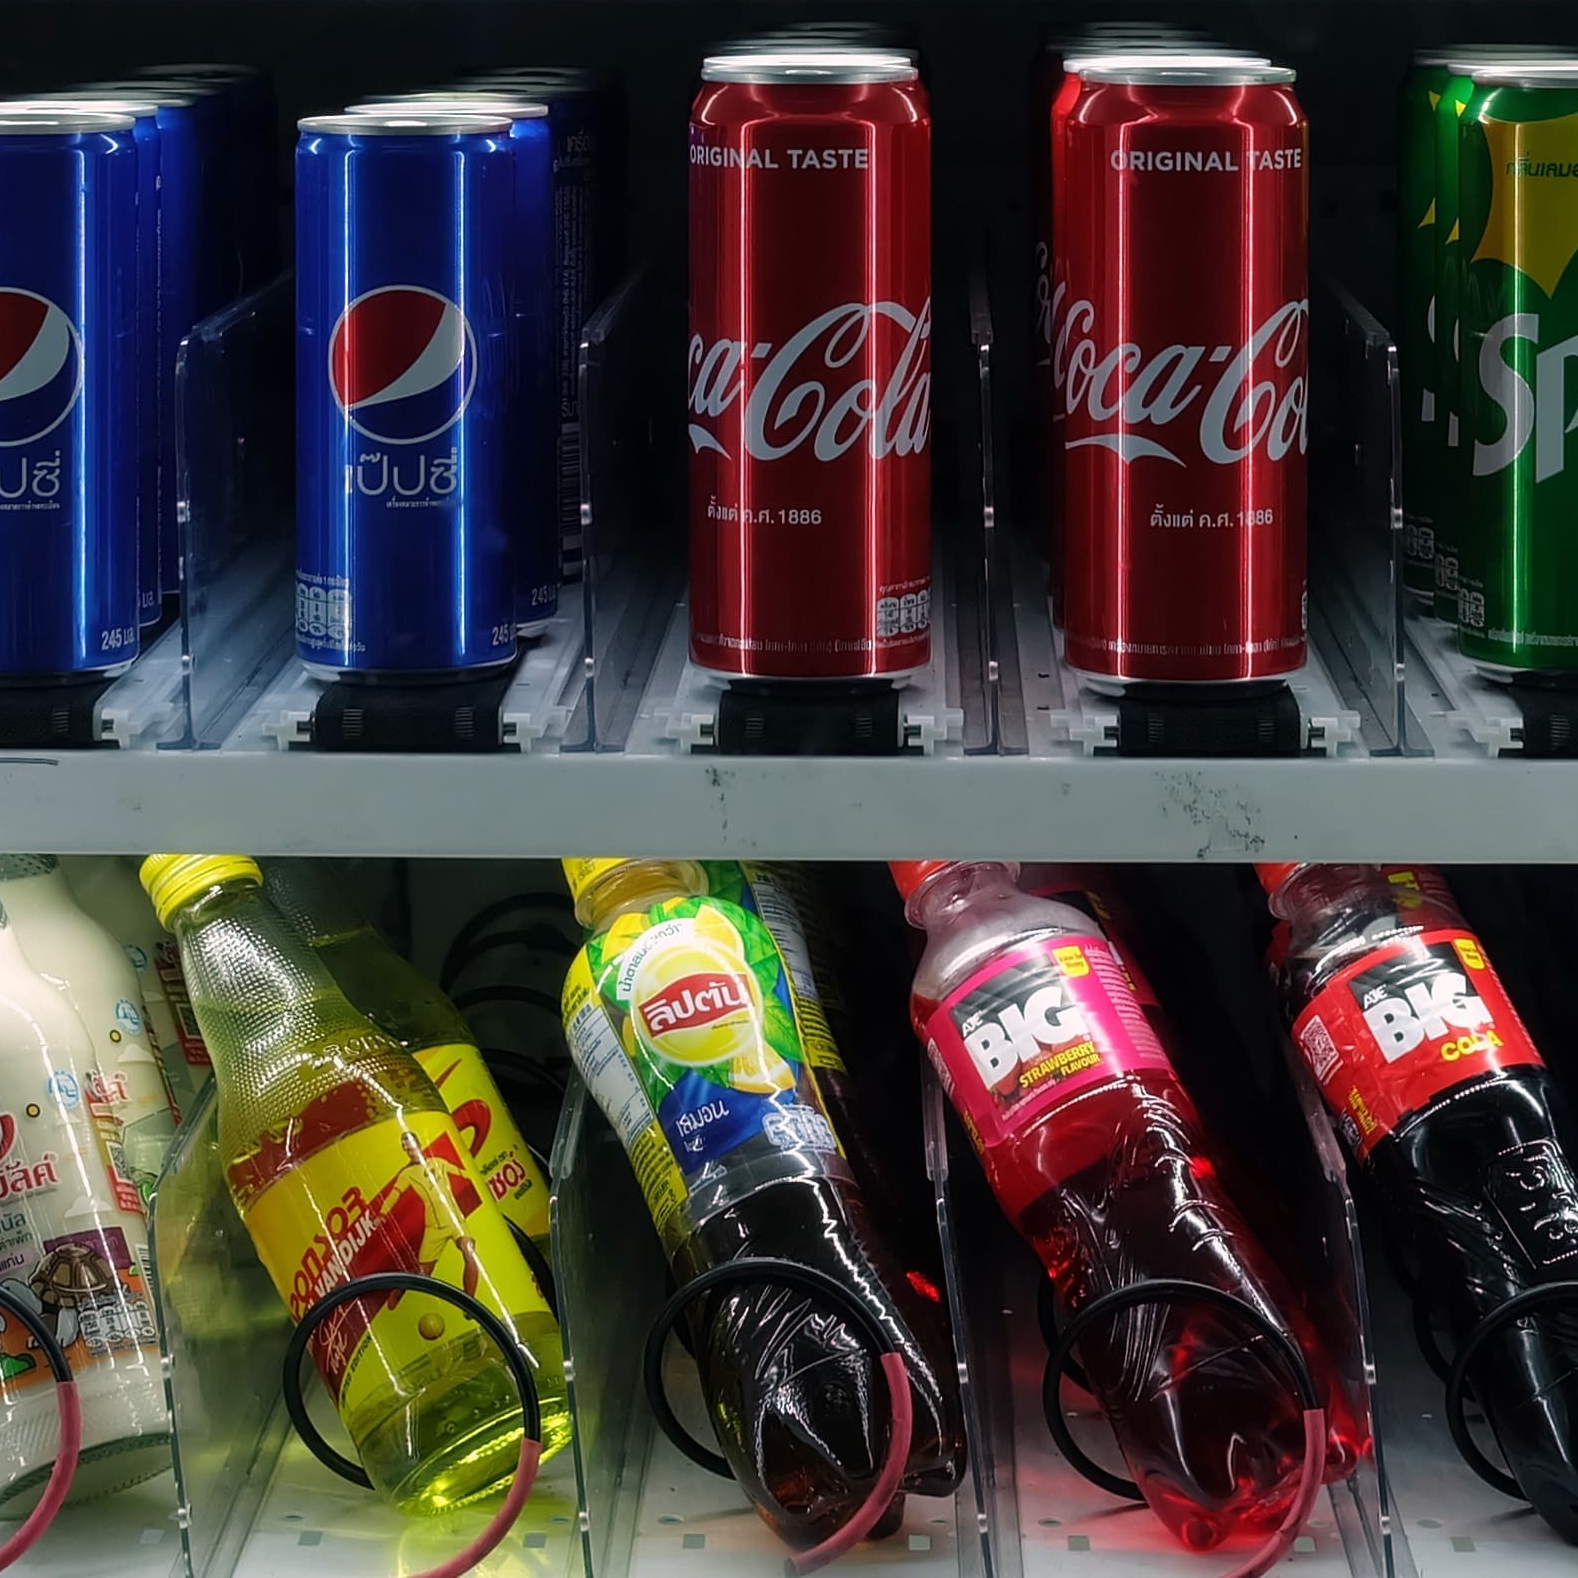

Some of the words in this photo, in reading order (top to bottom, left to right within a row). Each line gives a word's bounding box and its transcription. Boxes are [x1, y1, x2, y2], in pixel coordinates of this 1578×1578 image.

[689, 145, 778, 169] ORIGINAL
[787, 148, 870, 169] TASTE
[1111, 149, 1239, 172] ORIGINAL
[1247, 148, 1302, 170] TASTE
[689, 296, 931, 462] ca-Cola
[1065, 298, 1308, 465] Coca-Co
[344, 447, 458, 496] เป๊ปซี่
[778, 507, 822, 525] 1886
[1150, 503, 1193, 529] ตั้งแต่
[1236, 508, 1273, 526] 1886
[102, 628, 122, 651] 245
[492, 625, 509, 646] 245
[643, 980, 752, 1032] ลิปตัน
[1363, 983, 1387, 1010] AJE
[962, 1010, 983, 1037] AJE
[1362, 971, 1495, 1064] BIG
[963, 985, 1089, 1090] BIG
[1440, 1029, 1505, 1062] COLA
[1019, 1040, 1096, 1089] STRAWBERRY
[1060, 1053, 1101, 1078] FLAVOUR
[677, 1100, 730, 1139] เลมอน
[316, 1260, 340, 1300] VAN
[338, 1214, 375, 1267] DIJK
